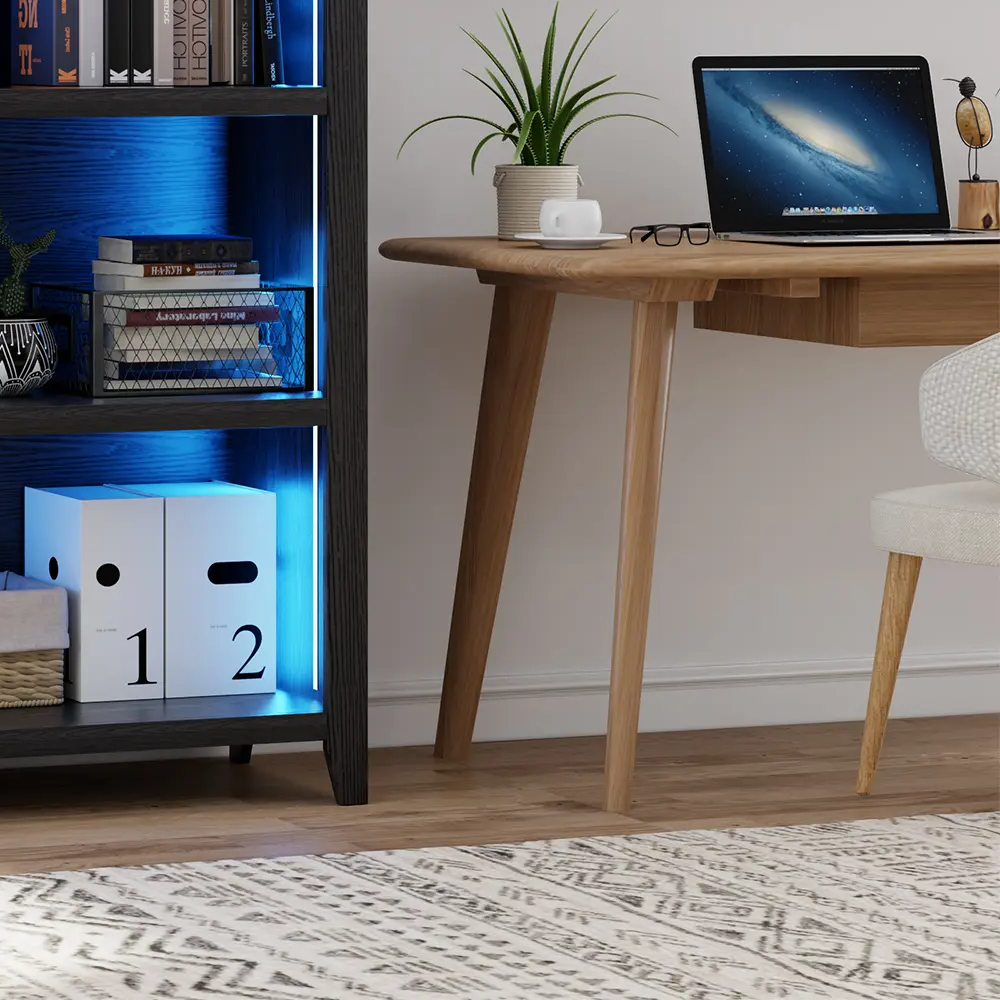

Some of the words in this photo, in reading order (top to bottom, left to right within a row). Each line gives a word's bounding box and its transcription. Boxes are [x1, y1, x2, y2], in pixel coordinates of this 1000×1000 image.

[241, 21, 249, 67] PORTRAITS
[126, 627, 158, 686] 1
[231, 624, 267, 680] 2
